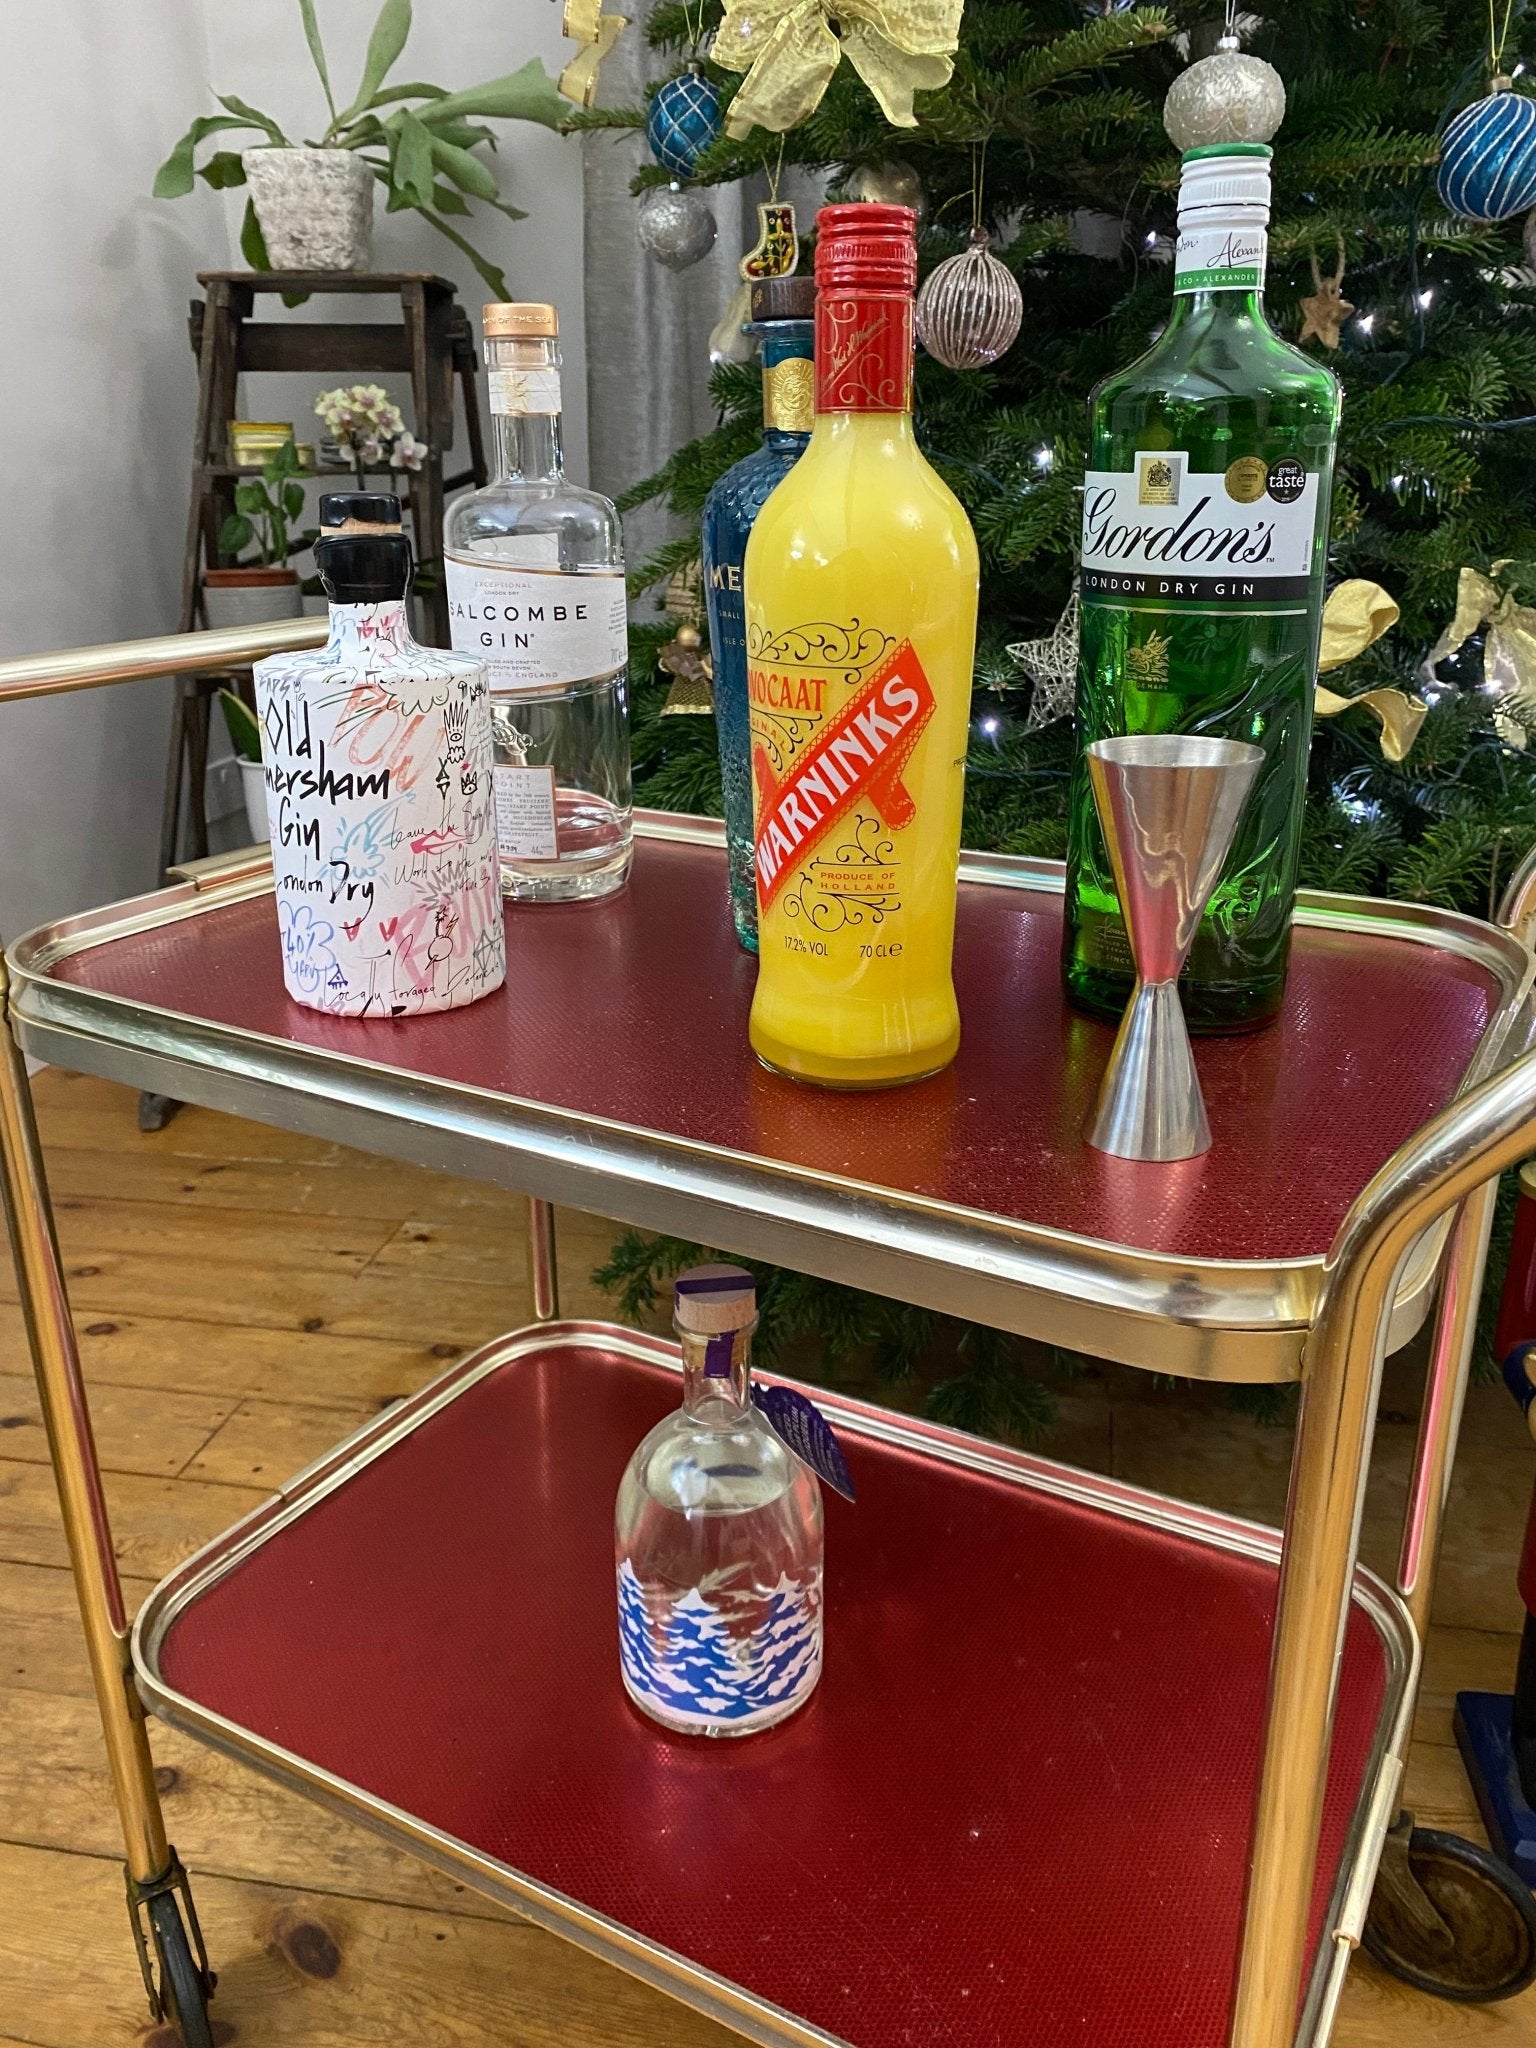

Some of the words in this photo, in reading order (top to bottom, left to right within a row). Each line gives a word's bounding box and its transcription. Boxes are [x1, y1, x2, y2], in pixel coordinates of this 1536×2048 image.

[1202, 273, 1256, 283] ALEXANDER
[1278, 466, 1298, 476] great
[1269, 475, 1305, 488] taste
[1083, 486, 1276, 564] Gordon's
[1085, 579, 1146, 592] LONDON
[1160, 582, 1200, 594] DRY
[1215, 584, 1254, 595] GIN
[450, 600, 588, 622] SALCOMBE
[719, 610, 741, 619] SMALL
[480, 632, 529, 648] GIN
[265, 698, 312, 759] Old
[755, 673, 919, 890] WARNINKS
[279, 796, 320, 861] Gin
[820, 871, 874, 880] PRODUCE
[820, 882, 896, 890] HOLLAND
[329, 860, 374, 930] Dry
[784, 935, 807, 953] 17.2%
[809, 941, 829, 956] VOL
[859, 945, 873, 958] 70
